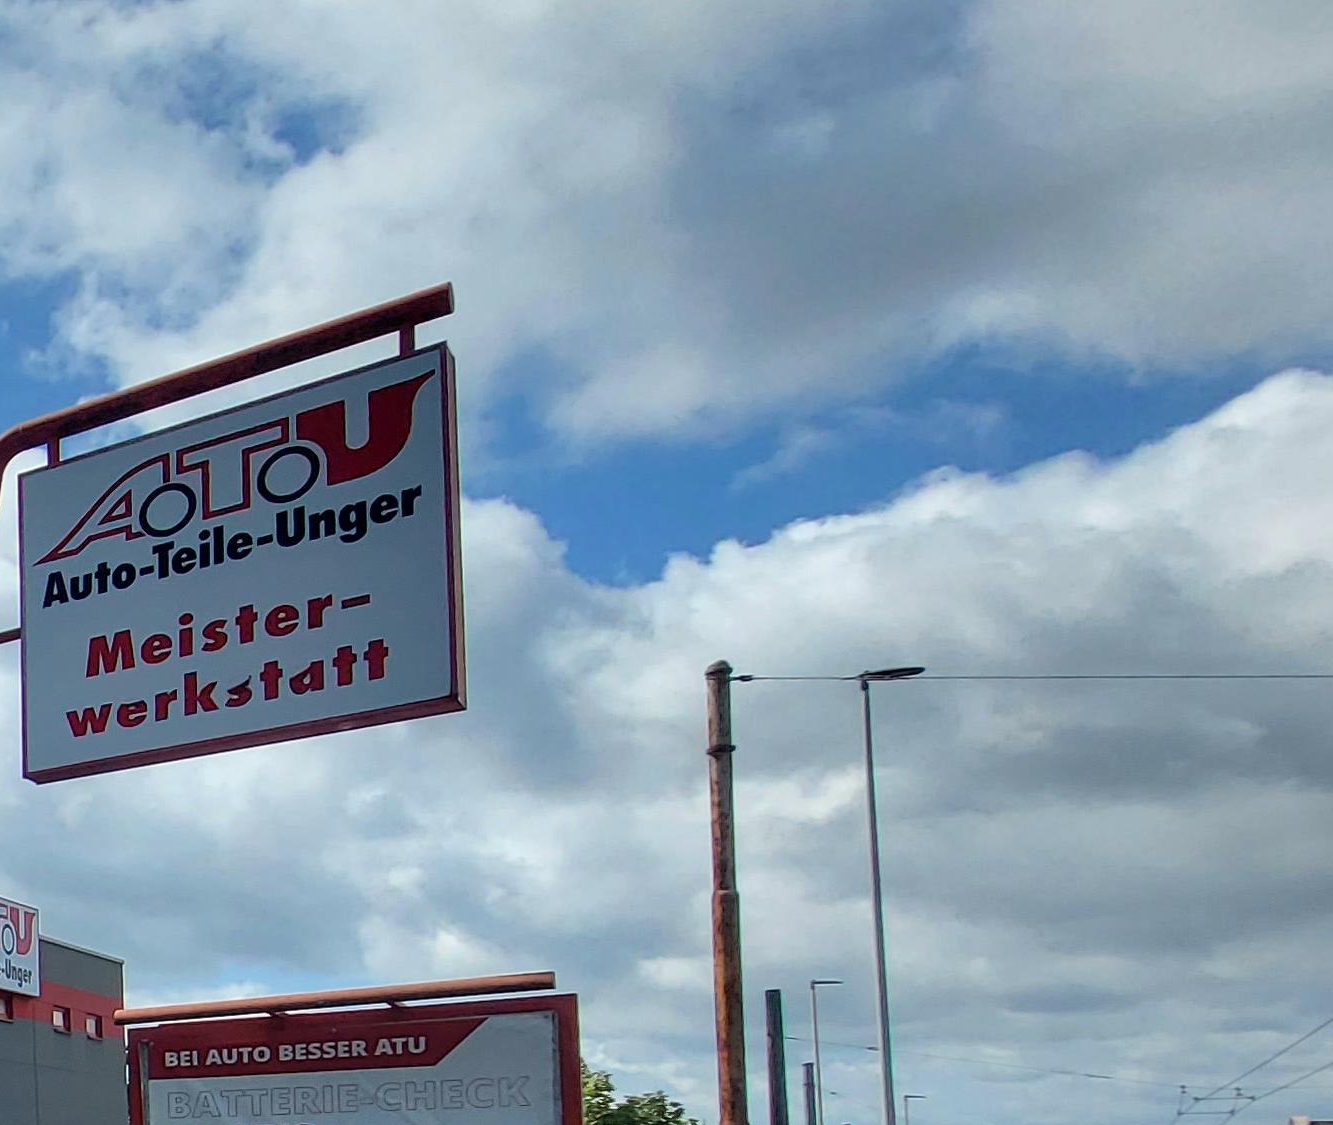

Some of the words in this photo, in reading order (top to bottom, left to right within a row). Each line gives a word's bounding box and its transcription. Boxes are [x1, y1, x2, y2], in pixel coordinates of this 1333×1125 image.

[35, 369, 436, 566] ATU
[42, 484, 422, 609] Auto-Teile-Unger
[85, 592, 371, 678] Meister-
[66, 638, 389, 738] werkstatt
[164, 1050, 199, 1068] BEI
[205, 1046, 271, 1065] AUTO
[278, 1040, 367, 1061] BESSER
[373, 1036, 427, 1056] ATU
[167, 1075, 532, 1120] BATTERIE-CHECK
